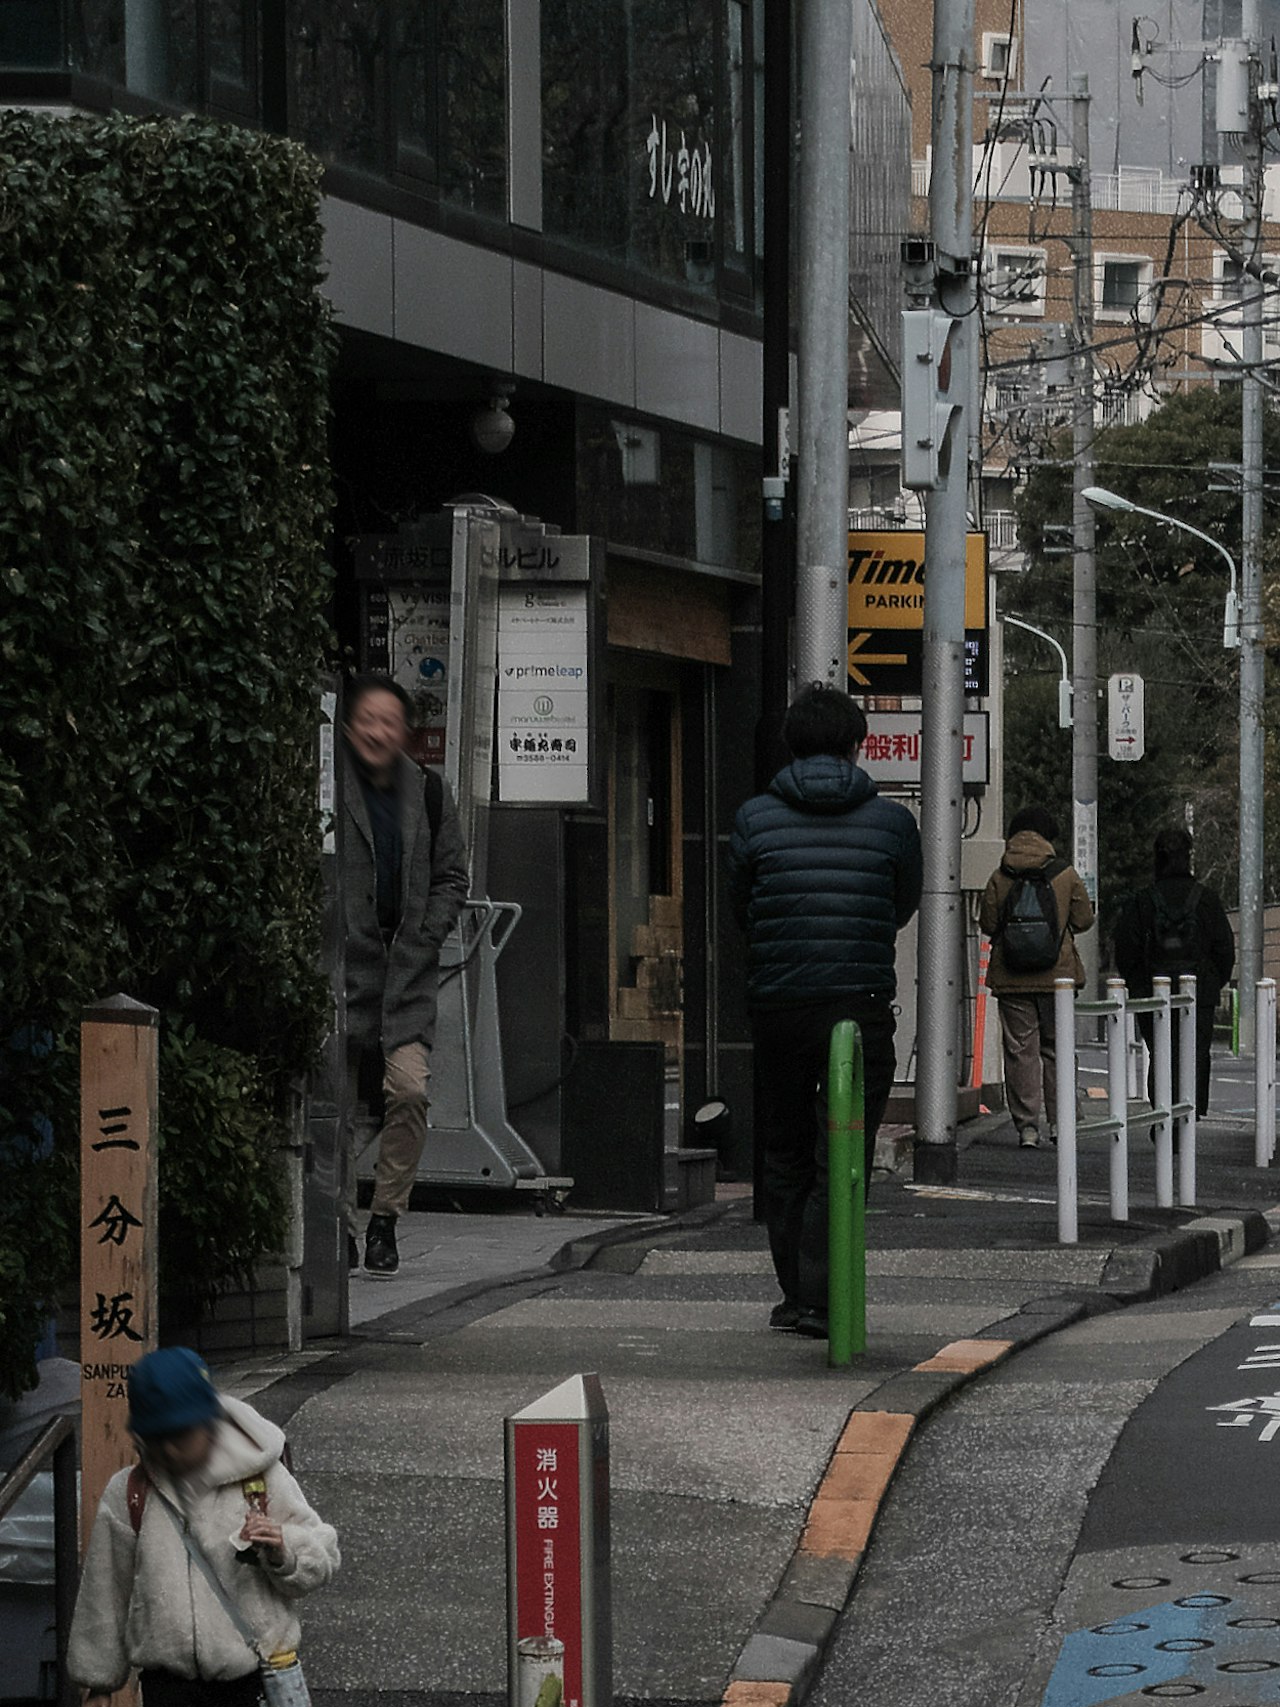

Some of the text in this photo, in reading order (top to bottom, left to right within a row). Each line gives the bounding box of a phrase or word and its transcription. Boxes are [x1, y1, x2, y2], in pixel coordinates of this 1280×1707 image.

[91, 1106, 144, 1343] 三分坂
[83, 1363, 131, 1381] SANPU
[106, 1382, 126, 1399] ZA
[536, 1448, 559, 1529] 消火器
[543, 1538, 554, 1570] FIRE
